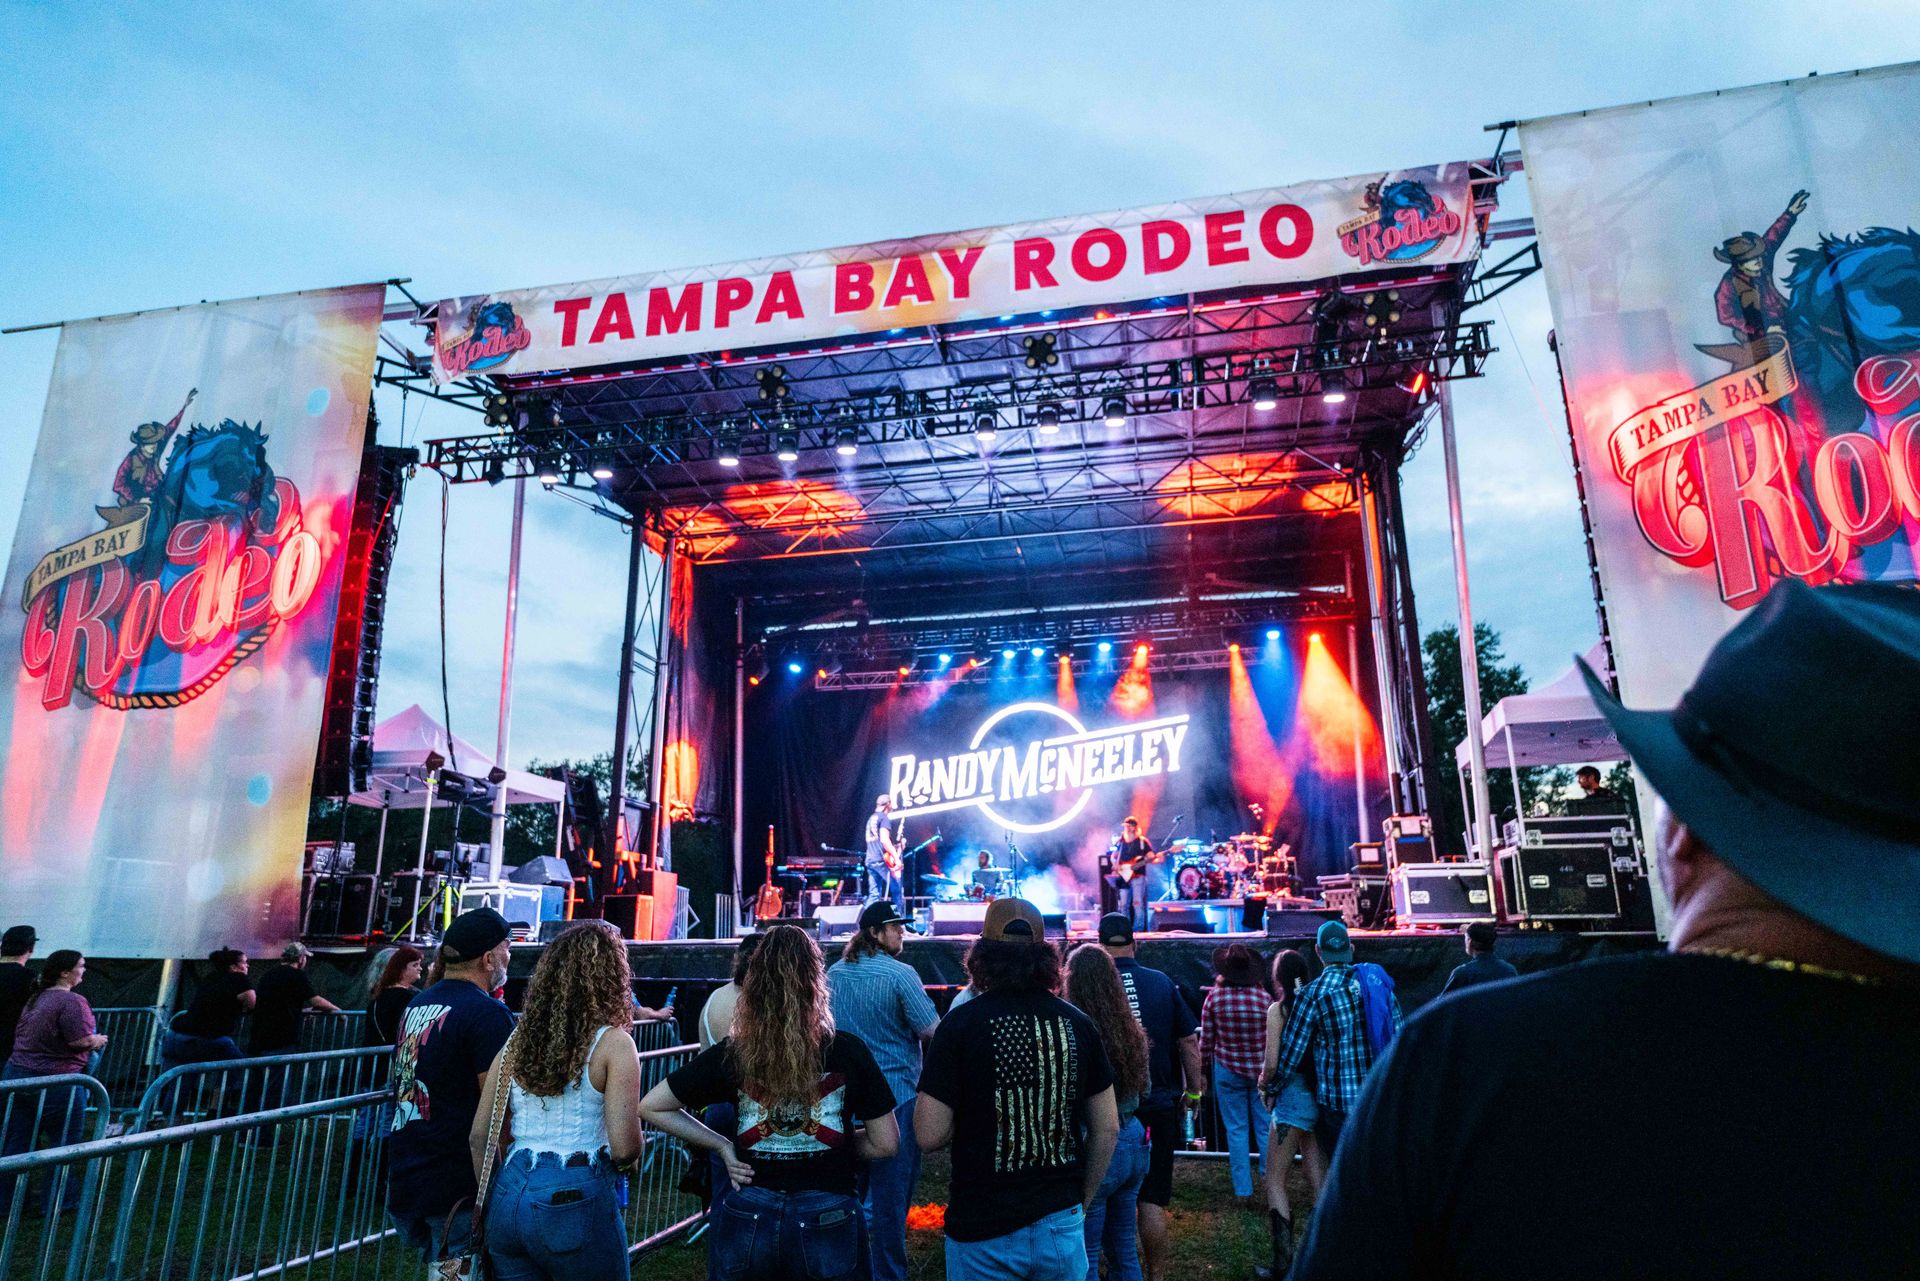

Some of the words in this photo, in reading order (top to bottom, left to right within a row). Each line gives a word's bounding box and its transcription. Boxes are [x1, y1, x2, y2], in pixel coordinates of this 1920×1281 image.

[1342, 194, 1461, 265] Rodeo
[554, 271, 805, 347] TAMPA
[834, 246, 987, 315] BAY
[1014, 203, 1314, 291] RODEO
[441, 315, 531, 379] Rodeo
[1629, 397, 1715, 450] TAMPA
[1721, 369, 1770, 409] BAY
[36, 542, 87, 586] TAMPA
[92, 529, 131, 557] BAY
[21, 477, 322, 712] Rodeo
[889, 746, 1000, 808] RANDY
[1063, 1017, 1079, 1081] SOUTHERN
